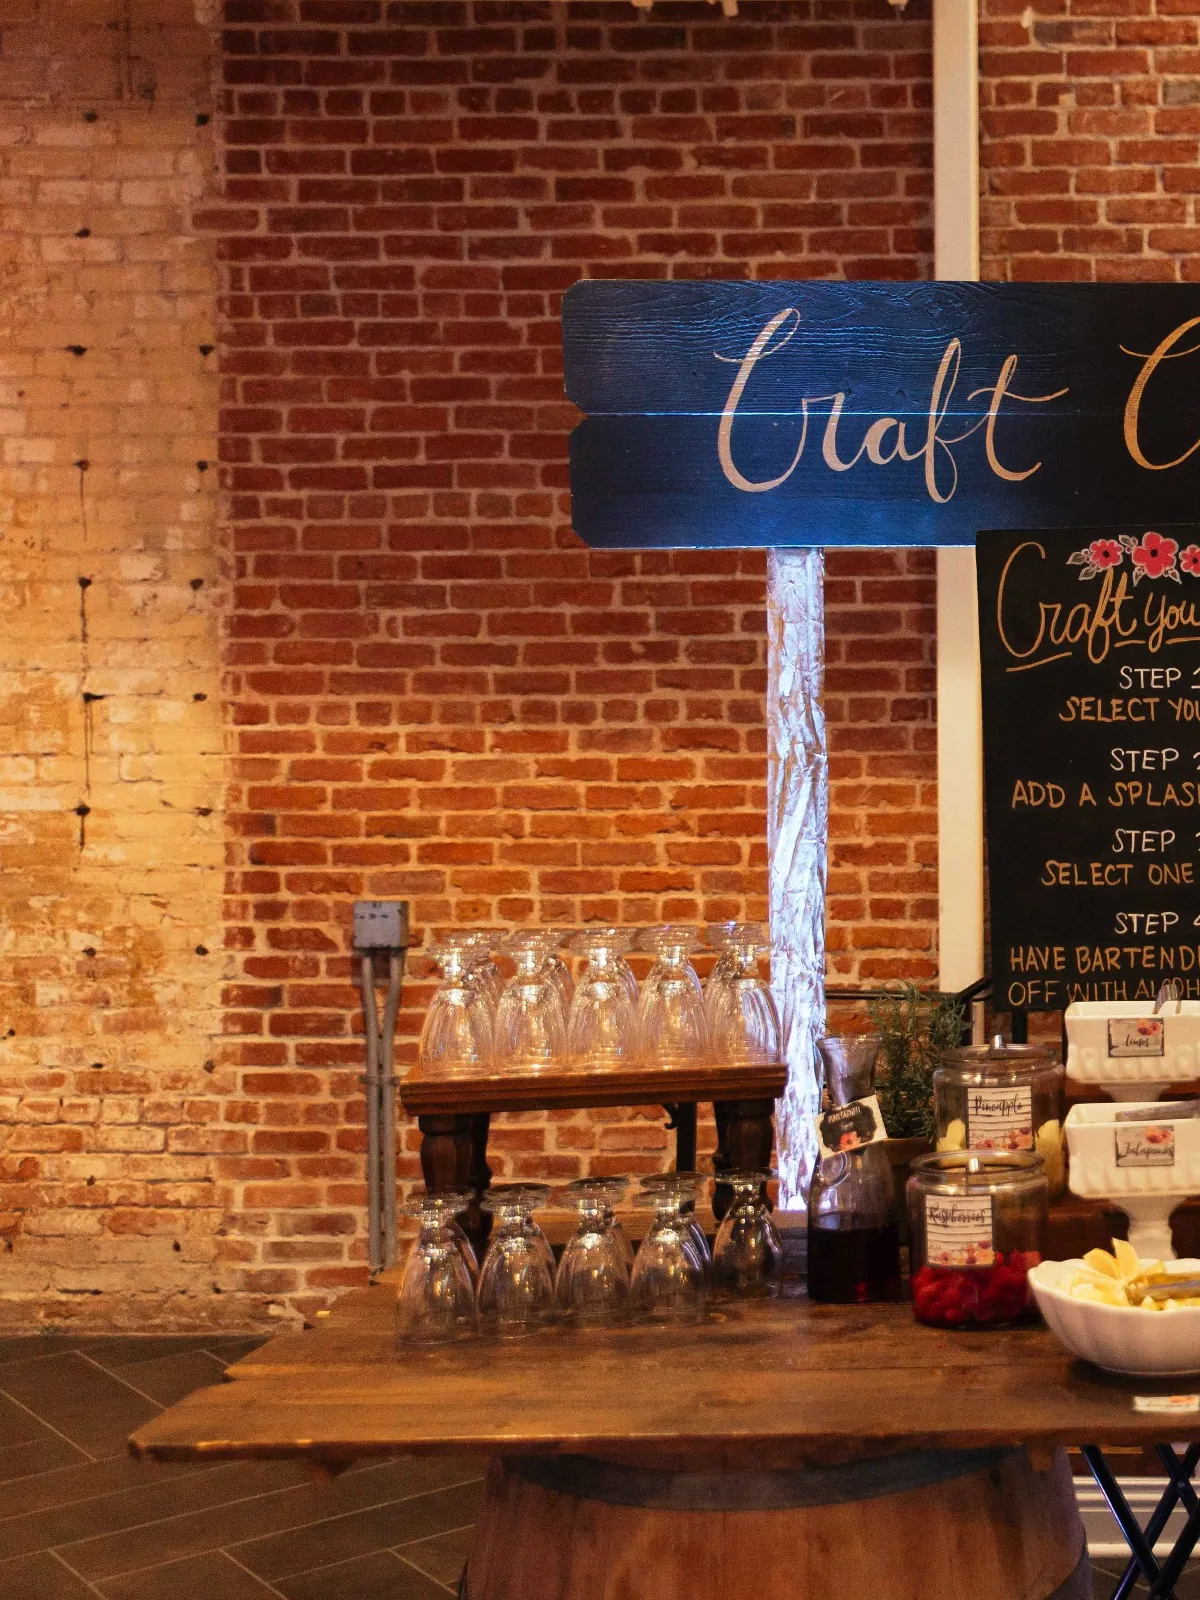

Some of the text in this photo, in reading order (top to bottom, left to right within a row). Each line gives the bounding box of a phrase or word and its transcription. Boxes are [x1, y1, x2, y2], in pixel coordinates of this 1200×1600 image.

[713, 308, 1069, 503] Craft
[997, 541, 1137, 663] Craft
[1119, 666, 1181, 689] STEP
[1058, 696, 1159, 723] SELECT
[1110, 748, 1179, 772] STEP
[1011, 779, 1065, 809] ADD
[1078, 783, 1097, 806] A
[1112, 828, 1175, 853] STEP
[1041, 859, 1133, 886] SELECT
[1148, 862, 1194, 885] ONE
[1114, 911, 1179, 935] STEP
[1010, 945, 1065, 972] HAVE
[1008, 979, 1060, 1006] OFF
[1066, 978, 1127, 1001] WITH
[973, 1093, 1024, 1117] Pineapple
[928, 1202, 986, 1228] Raspberries
